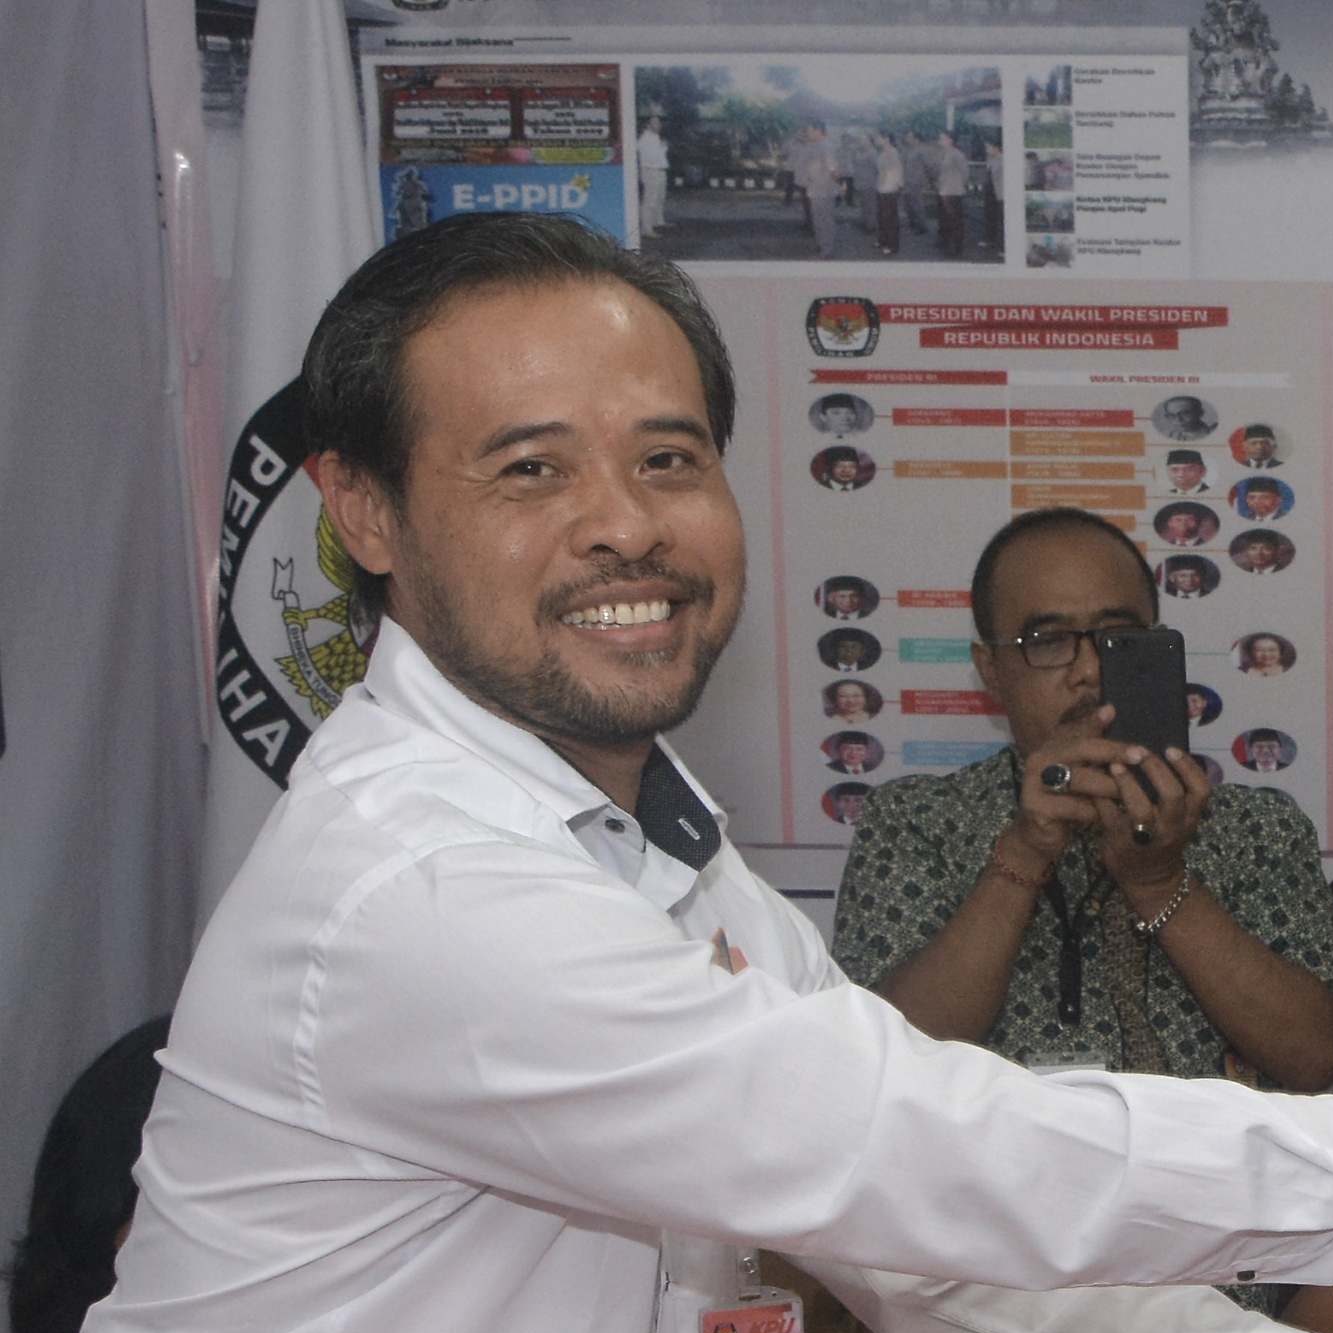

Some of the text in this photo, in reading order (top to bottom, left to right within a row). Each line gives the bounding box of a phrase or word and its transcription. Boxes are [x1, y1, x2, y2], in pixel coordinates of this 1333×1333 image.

[453, 181, 590, 210] E-PPID
[891, 307, 1208, 323] PRESIDEN DAN WAKIL PRESIDEN
[944, 331, 1154, 346] REPUBLIK INDONESIA
